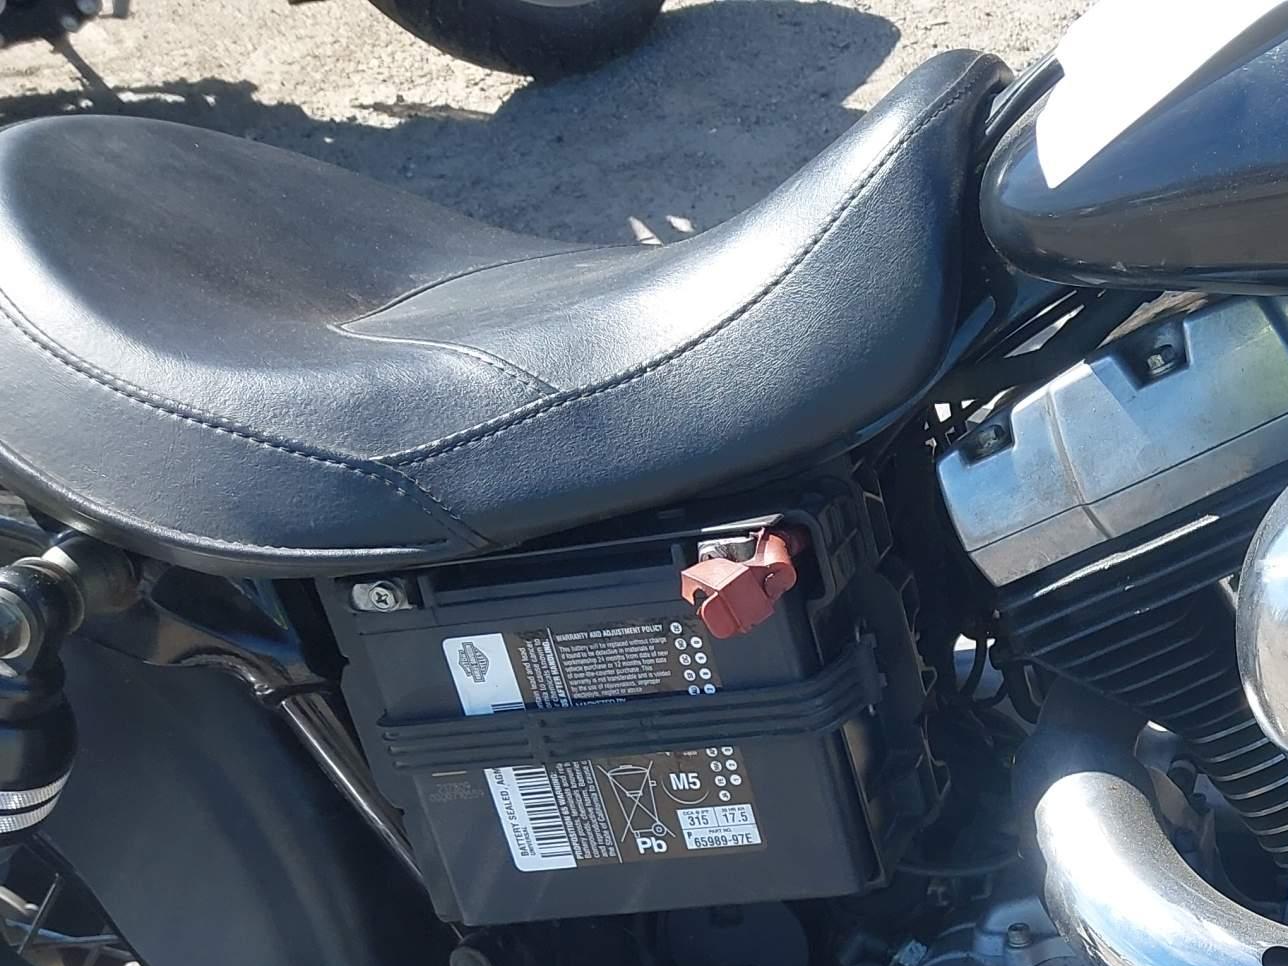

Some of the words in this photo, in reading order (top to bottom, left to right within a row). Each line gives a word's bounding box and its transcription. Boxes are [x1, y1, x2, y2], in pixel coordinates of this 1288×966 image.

[555, 631, 589, 641] WARRANTY
[588, 630, 602, 638] AND
[601, 626, 641, 637] ADJUSTMENT
[640, 624, 663, 633] POLICY
[553, 675, 565, 697] AFTER
[669, 772, 700, 790] M5
[687, 815, 709, 826] 315
[722, 812, 748, 824] 17.5
[511, 822, 529, 856] BATTERY
[521, 826, 536, 855] UNIVERSAL
[636, 836, 668, 854] Pb
[694, 833, 752, 848] 65989-97E
